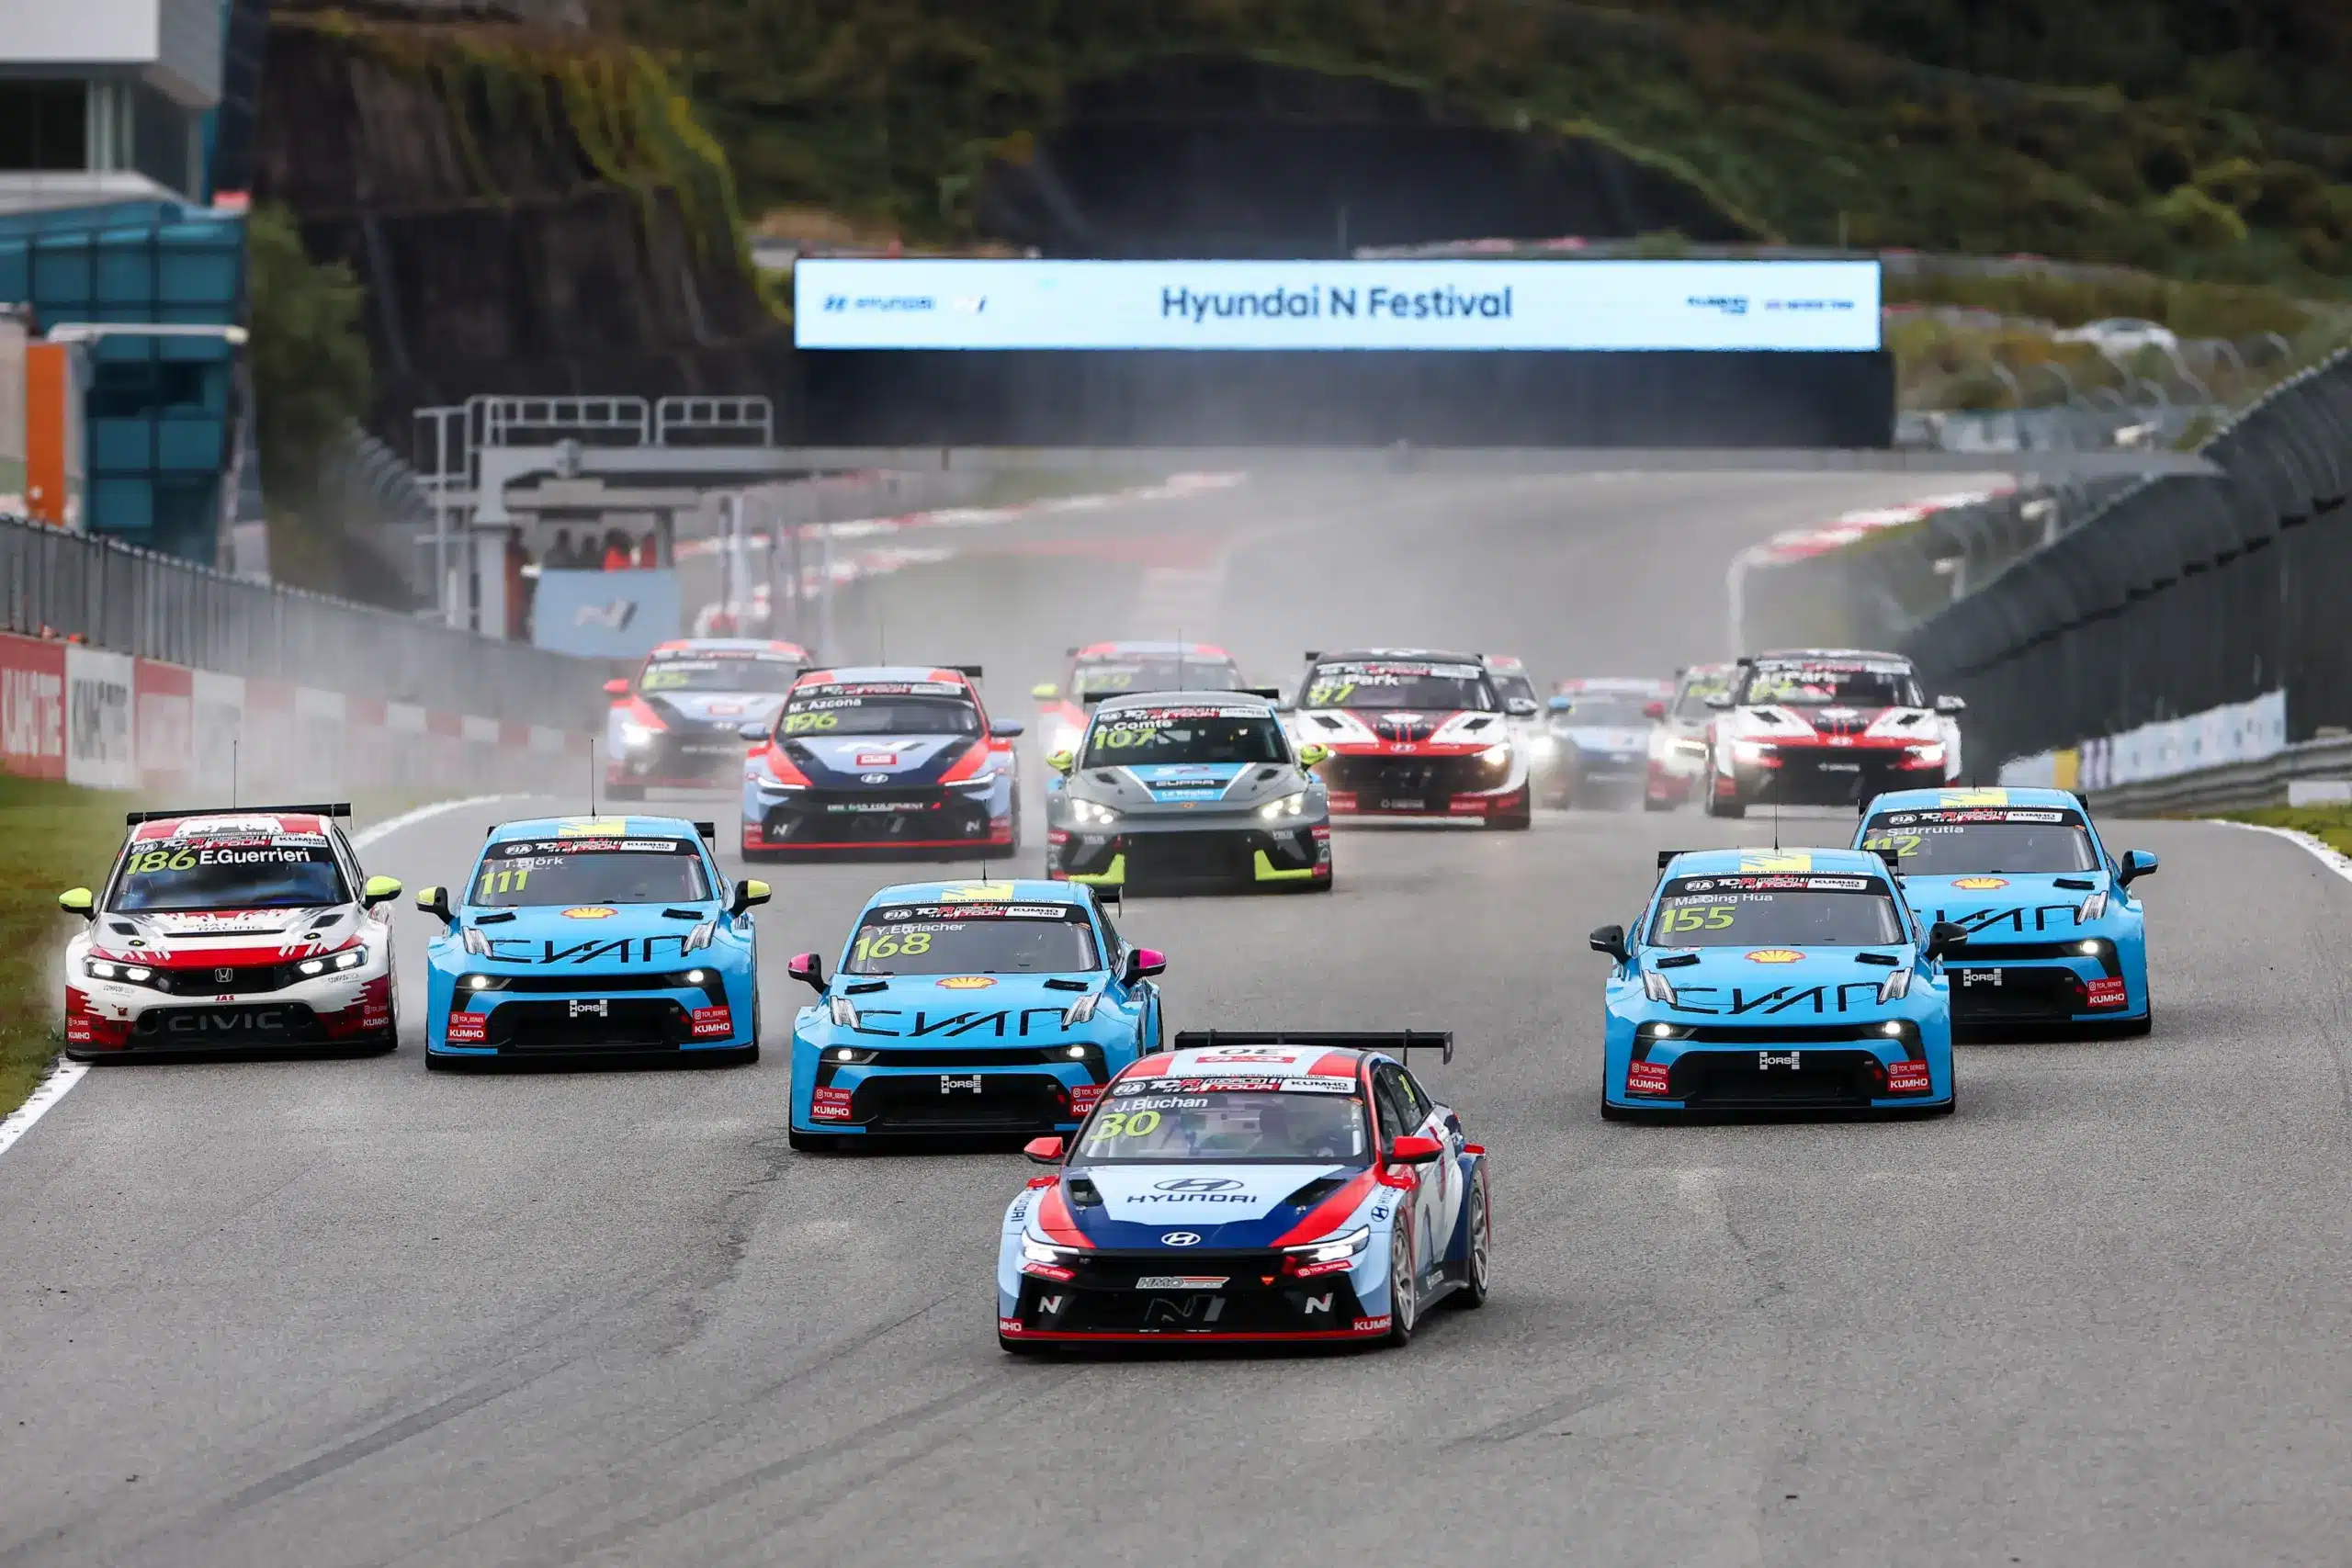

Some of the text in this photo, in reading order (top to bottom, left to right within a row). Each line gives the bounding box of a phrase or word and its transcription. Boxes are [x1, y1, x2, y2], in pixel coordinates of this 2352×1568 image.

[1163, 288, 1510, 321] Hyundai N Festival
[784, 711, 838, 733] 196
[1093, 728, 1157, 750] 107
[198, 847, 311, 865] E.Guerrieri
[506, 844, 532, 855] FIA
[126, 851, 197, 875] 186
[481, 870, 530, 896] 111
[1687, 881, 1713, 891] FIA
[1675, 893, 1773, 907] Ma Qing Hua
[885, 909, 910, 919] FIA
[1660, 907, 1737, 934] 155
[854, 932, 932, 962] 168
[1963, 970, 2002, 985] HORSE
[214, 994, 235, 1002] JAS
[2089, 993, 2125, 1004] KUMHO
[570, 1001, 607, 1016] HORSE
[168, 1011, 284, 1032] CIVIC
[362, 1016, 390, 1028] KUMHO
[695, 1021, 730, 1033] KUMHO
[67, 1031, 91, 1041] KUMHO
[448, 1028, 484, 1039] KUMHO
[1759, 1054, 1800, 1068] HORSE
[941, 1077, 982, 1092] HORSE
[1114, 1083, 1144, 1095] FIA
[1149, 1078, 1202, 1090] TCR
[1291, 1079, 1348, 1088] KUMHO
[1629, 1078, 1668, 1090] KUMHO
[1890, 1077, 1928, 1089] KUMHO
[813, 1104, 850, 1116] KUMHO
[1114, 1096, 1209, 1113] J.Buchan
[1091, 1111, 1162, 1142] 30
[1126, 1193, 1258, 1203] HYUNDAI
[1136, 1278, 1183, 1290] HMO
